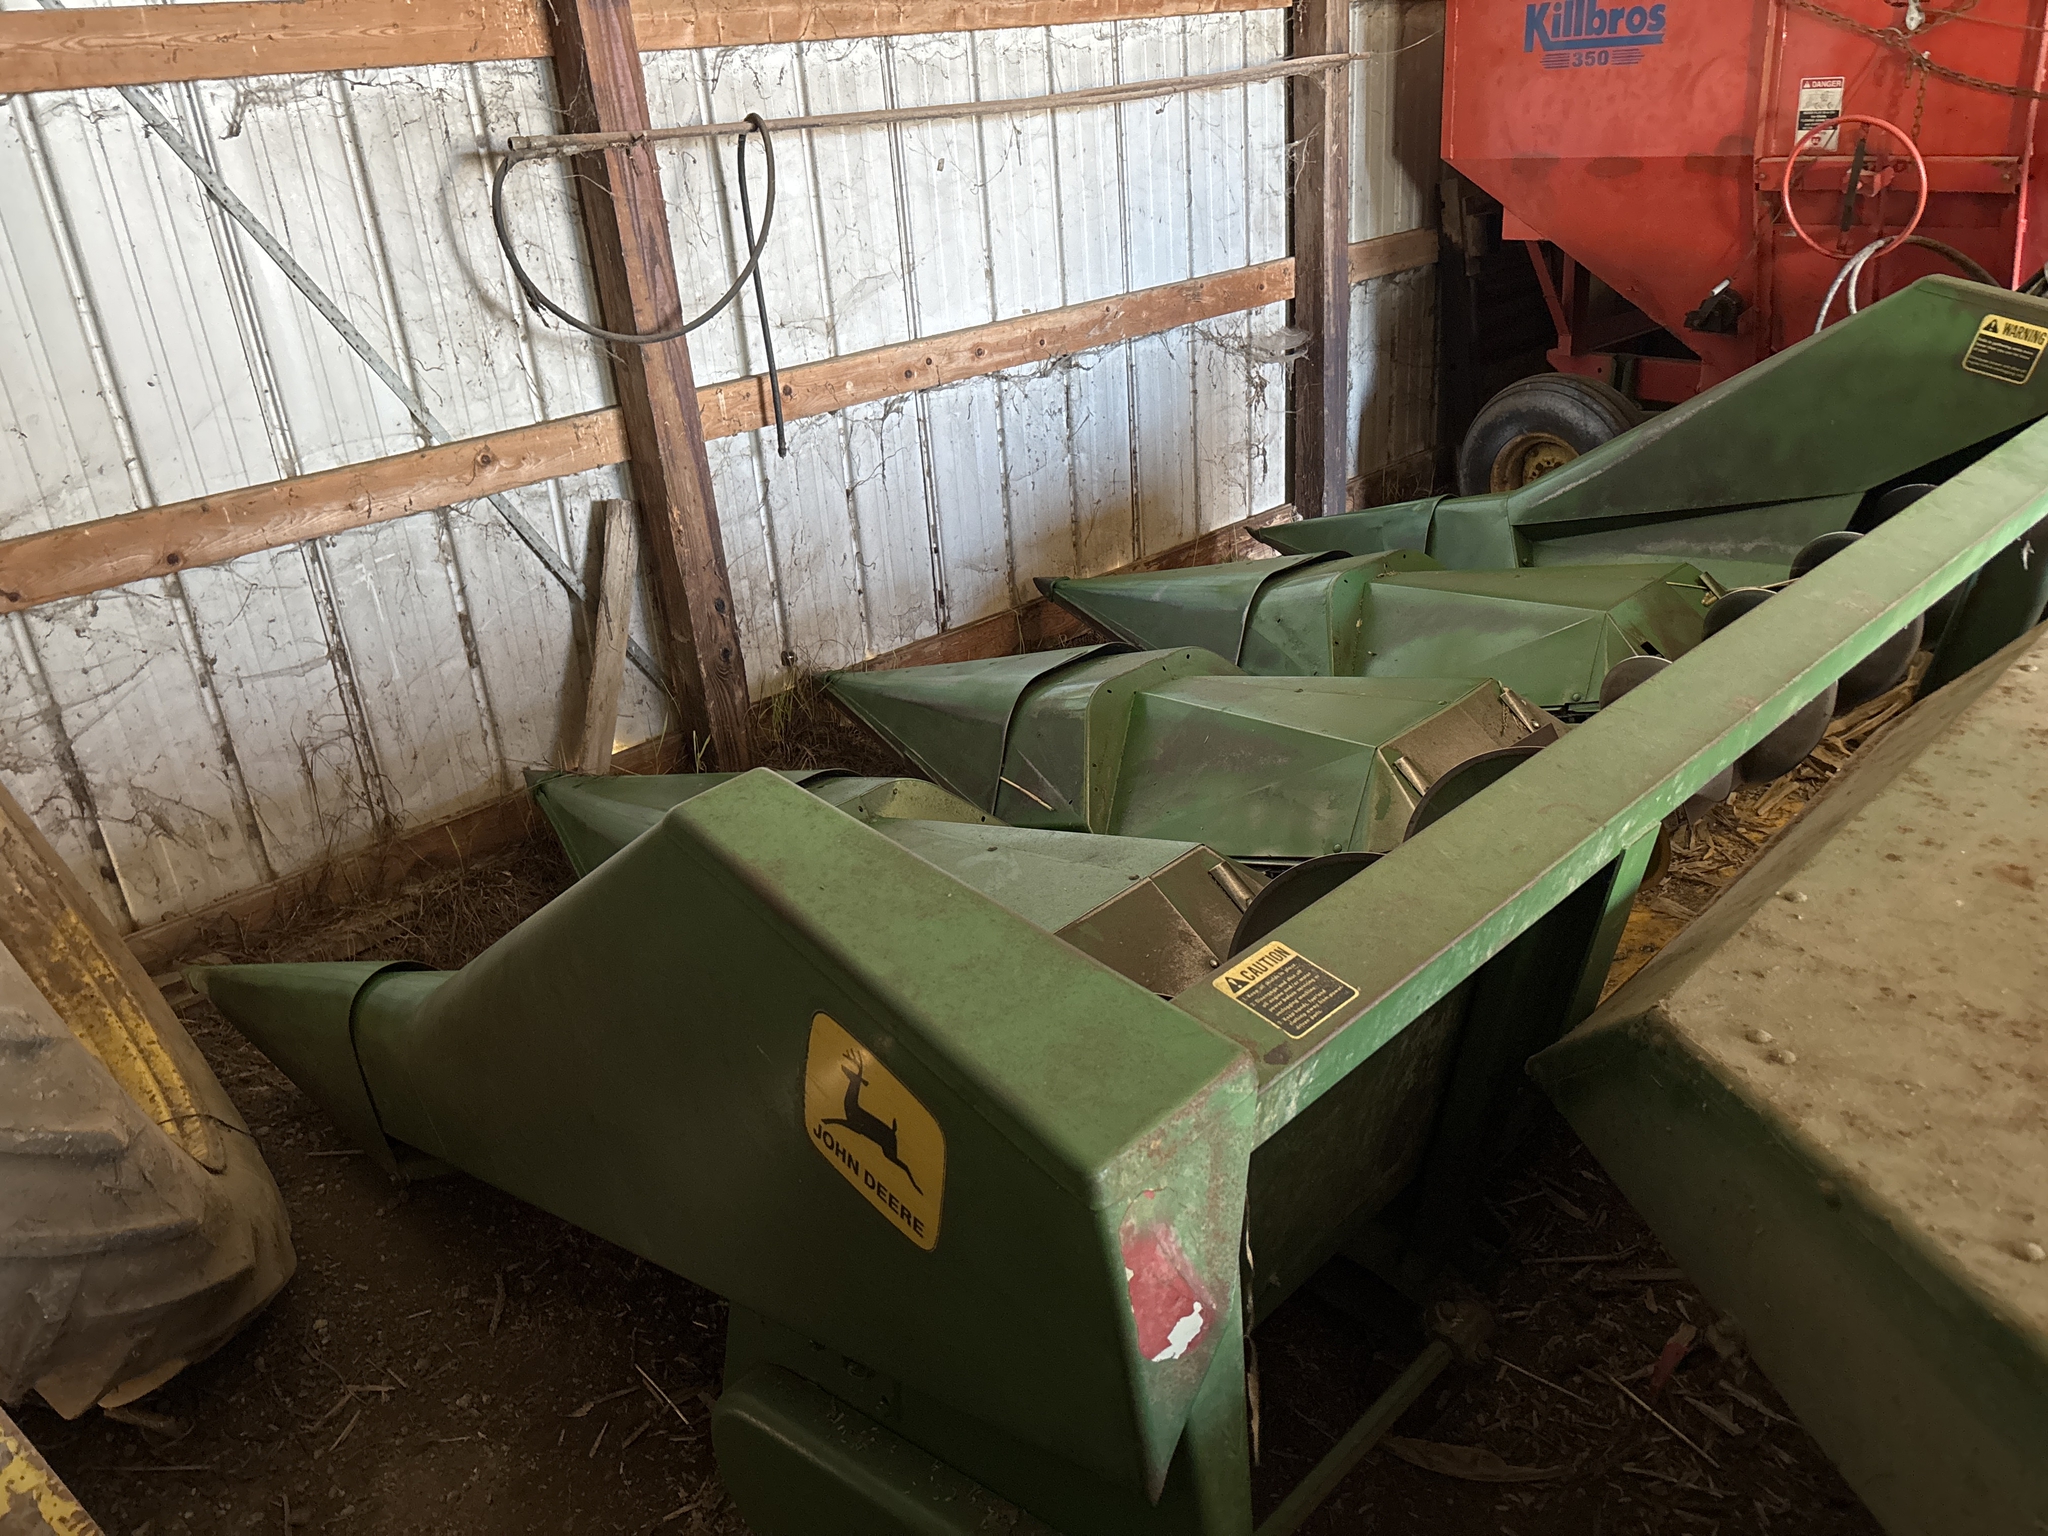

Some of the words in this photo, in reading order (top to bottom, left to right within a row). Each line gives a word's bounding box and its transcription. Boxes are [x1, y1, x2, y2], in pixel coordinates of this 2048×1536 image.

[1524, 0, 1667, 53] Killbros
[1572, 50, 1609, 67] 350
[2002, 323, 2047, 345] WARNING
[1240, 947, 1291, 981] CAUTION
[813, 1124, 859, 1176] JOHN
[864, 1169, 924, 1238] DEERE
